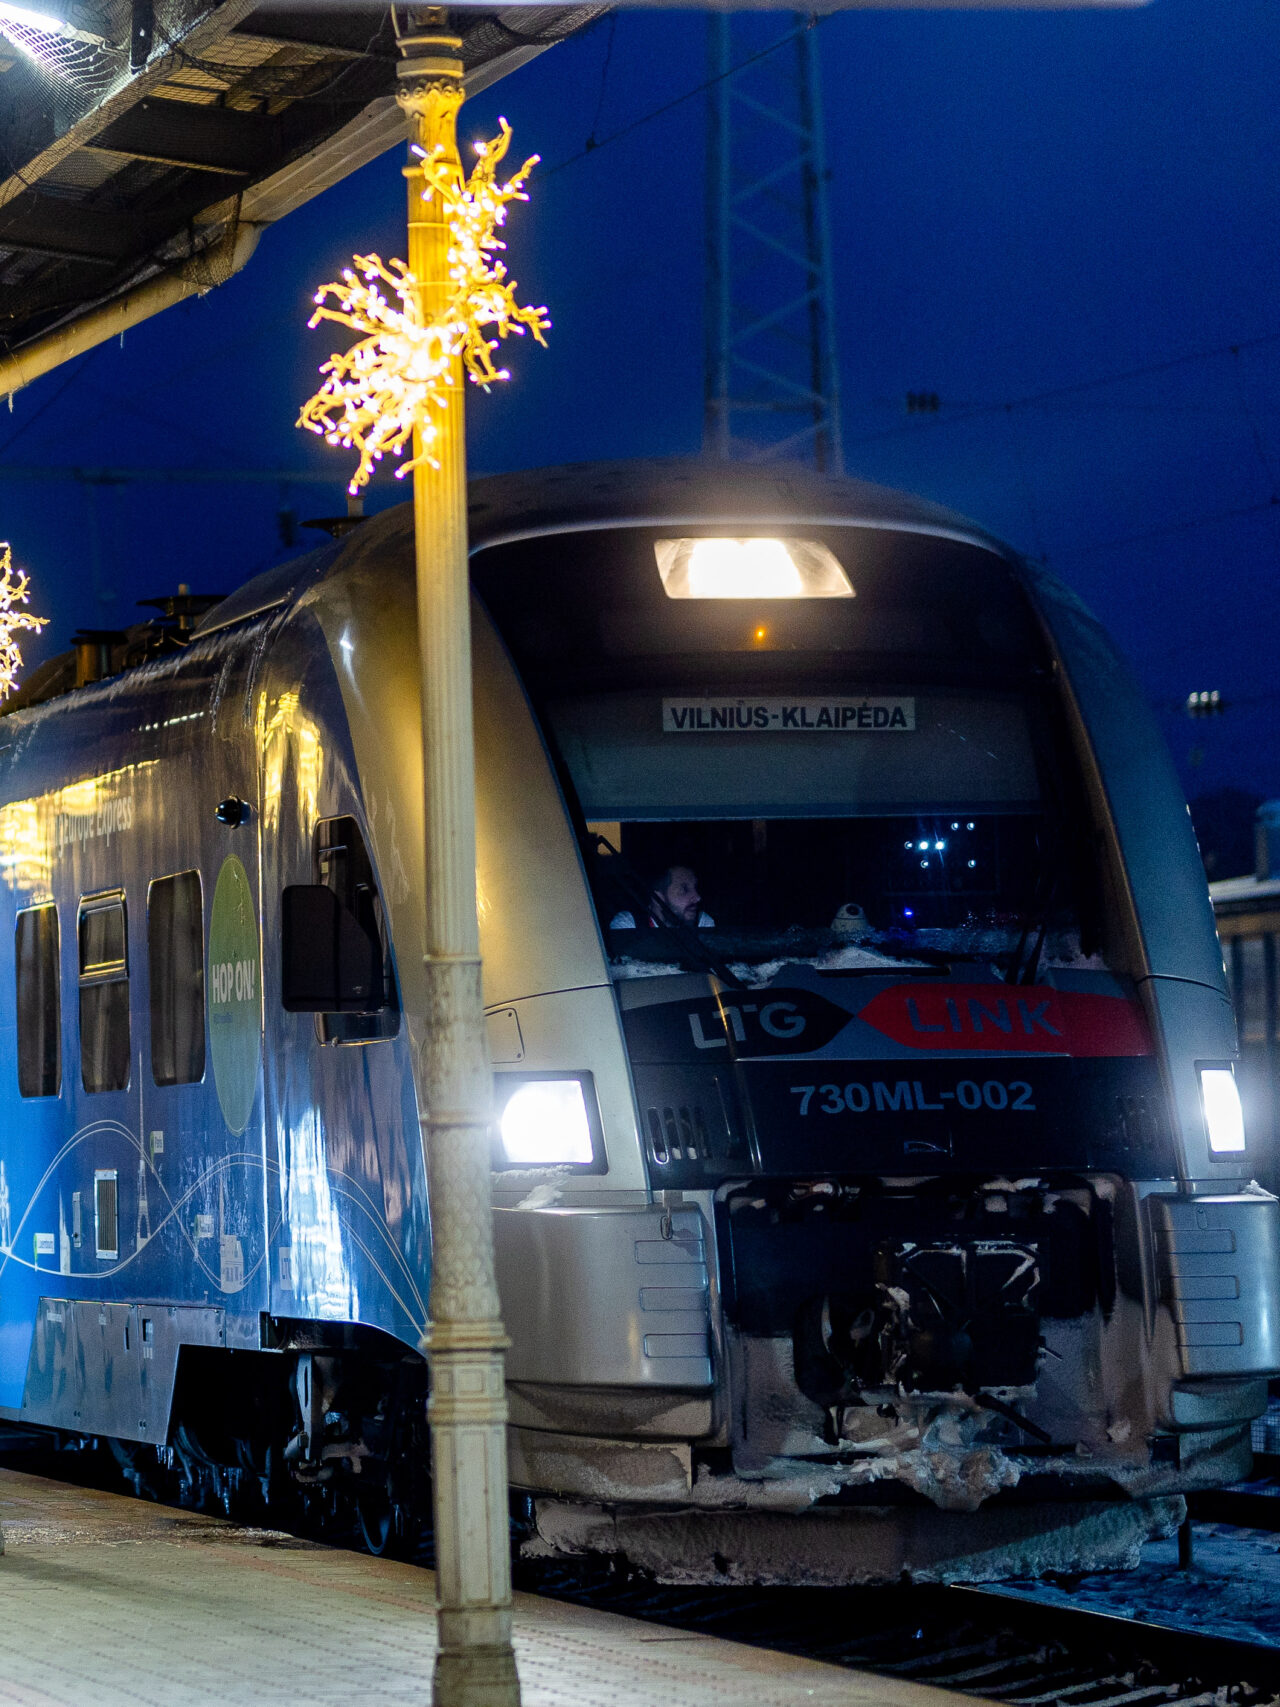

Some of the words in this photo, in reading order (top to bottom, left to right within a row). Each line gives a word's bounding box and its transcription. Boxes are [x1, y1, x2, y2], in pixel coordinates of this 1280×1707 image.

[97, 796, 132, 847] Express
[212, 962, 234, 1004] HOP
[235, 959, 256, 1002] ON!
[688, 1001, 807, 1049] LTG
[906, 998, 1063, 1037] LINK
[790, 1080, 1037, 1117] 730ML-002
